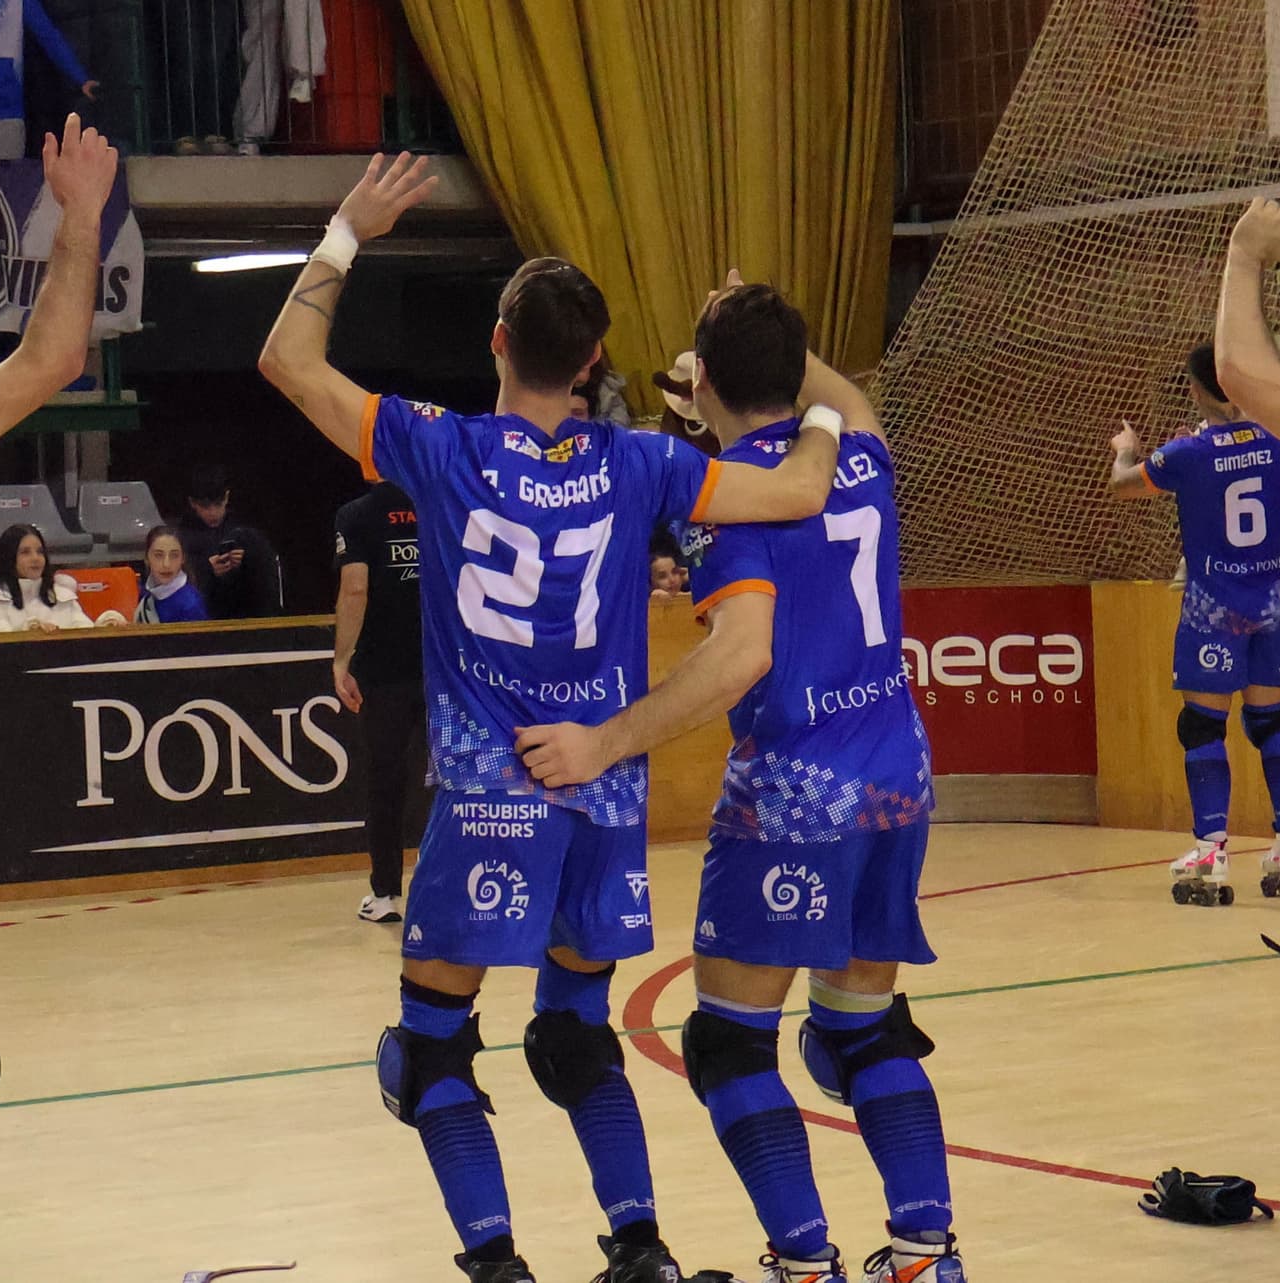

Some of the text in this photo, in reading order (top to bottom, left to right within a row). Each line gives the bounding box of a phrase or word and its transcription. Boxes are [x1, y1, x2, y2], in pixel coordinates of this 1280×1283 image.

[1214, 449, 1274, 473] GIMENEZ
[387, 510, 418, 525] STA
[1224, 476, 1268, 548] 6
[456, 507, 615, 651] 27
[823, 504, 888, 648] 7
[964, 688, 1082, 705] SCHOOL
[71, 694, 350, 807] PONS
[451, 802, 549, 820] MITSUBISHI
[461, 821, 535, 839] MOTORS
